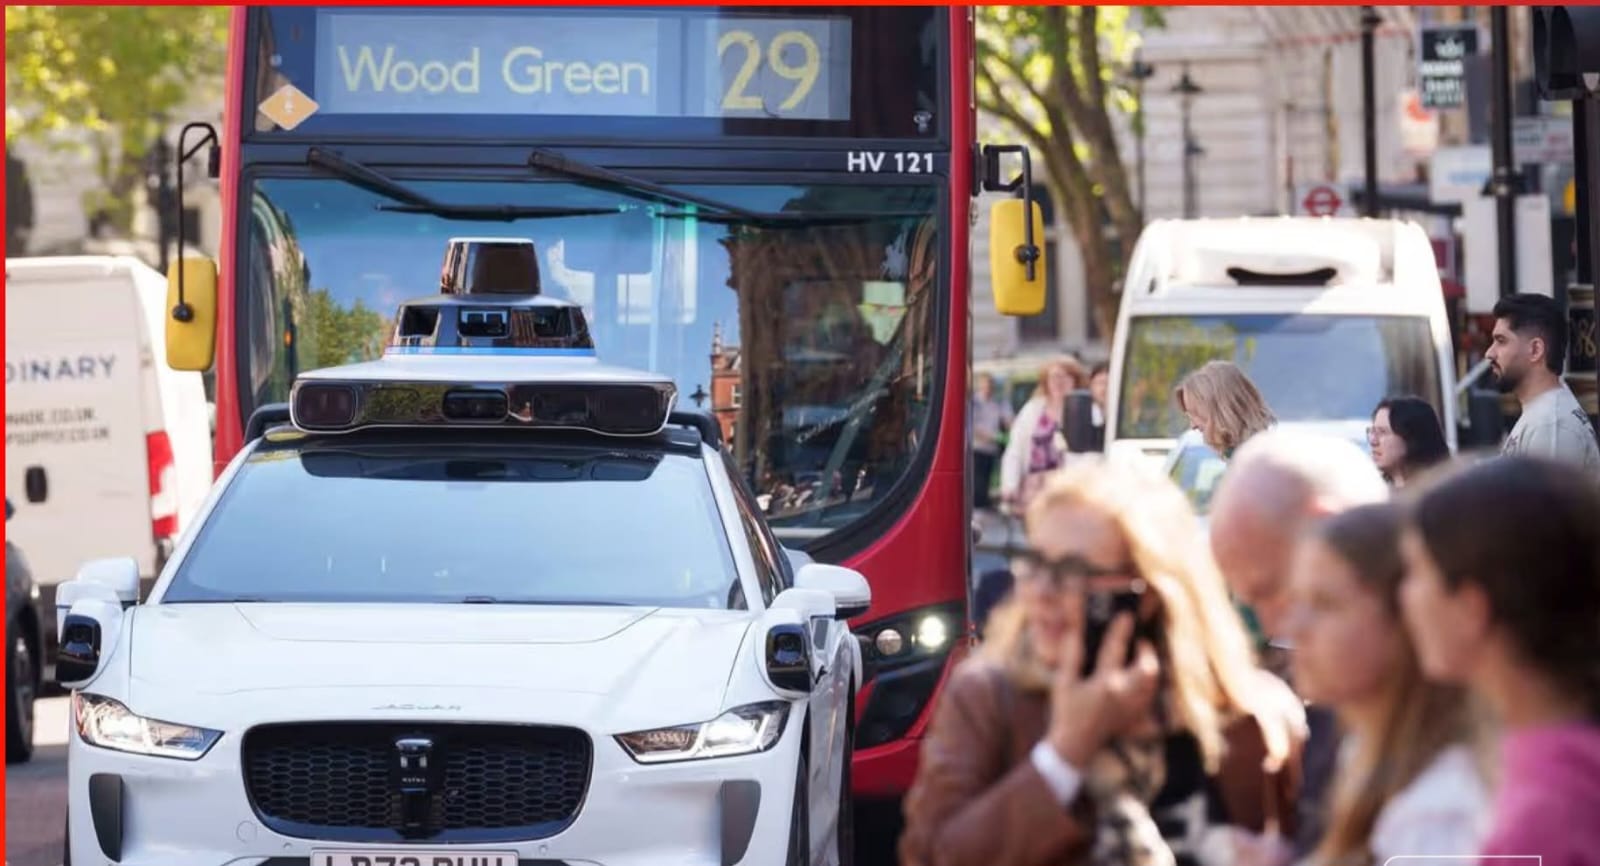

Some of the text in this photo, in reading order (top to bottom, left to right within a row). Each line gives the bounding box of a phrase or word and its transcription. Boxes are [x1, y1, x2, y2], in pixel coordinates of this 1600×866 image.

[337, 46, 650, 94] Wood Green
[717, 31, 820, 110] 29
[847, 151, 933, 173] HV 121
